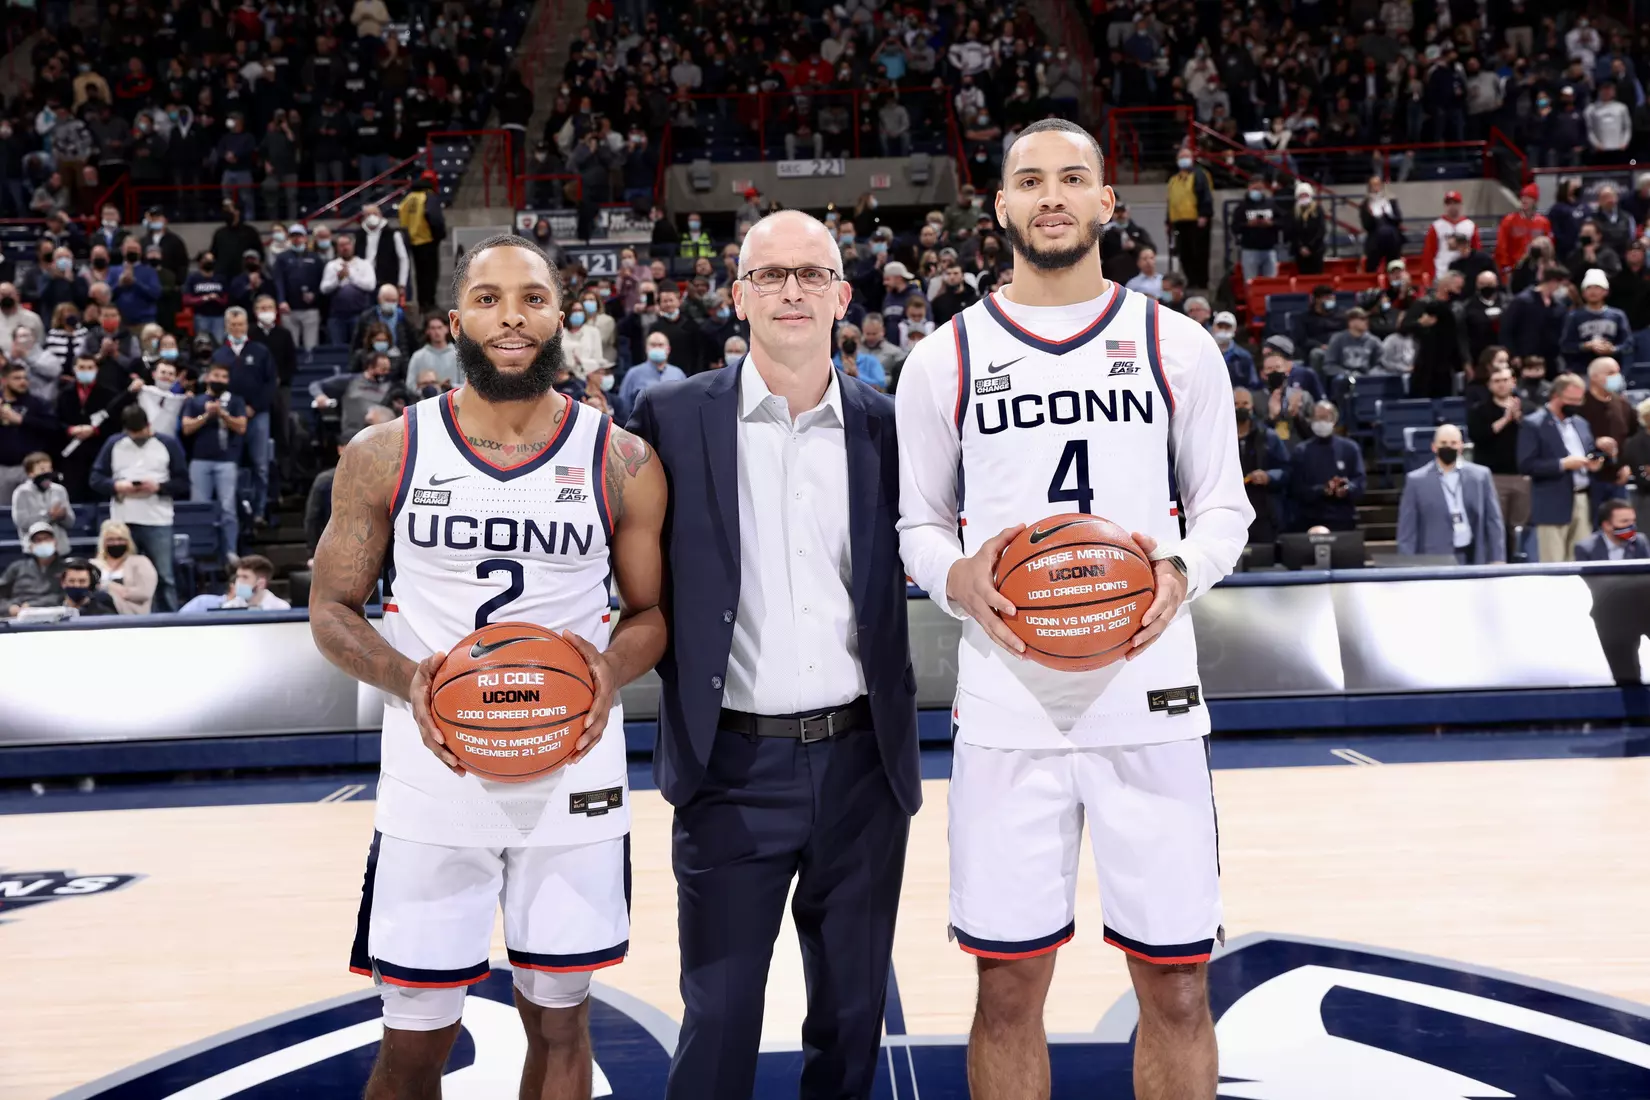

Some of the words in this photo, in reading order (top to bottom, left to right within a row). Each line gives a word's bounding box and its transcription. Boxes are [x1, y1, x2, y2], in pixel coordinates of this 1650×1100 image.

[811, 158, 844, 176] 221
[580, 253, 618, 276] 121
[976, 384, 1009, 394] CHANGE
[976, 389, 1152, 434] UCONN
[1047, 439, 1094, 514] 4
[413, 497, 449, 505] CHANGE
[557, 493, 588, 501] EAST
[408, 512, 593, 555] UCONN
[1025, 551, 1073, 572] TYRESE
[1077, 549, 1125, 561] MARTIN
[1049, 564, 1106, 582] UCONN
[475, 558, 524, 631] 2
[1053, 585, 1093, 597] CAREER
[1095, 580, 1128, 592] POINTS
[1026, 615, 1059, 626] UCONN
[1062, 617, 1078, 625] VS
[1081, 602, 1137, 624] MARQUETTE
[1036, 627, 1090, 637] DECEMBER
[1093, 624, 1107, 633] 21,
[1108, 616, 1130, 630] 2021
[477, 673, 499, 687] RJ
[503, 672, 545, 685] COLE
[482, 690, 540, 704] UCONN
[456, 709, 484, 720] 2,000
[487, 707, 529, 720] CAREER
[531, 705, 567, 717] POINTS
[455, 730, 489, 746] UCONN
[491, 739, 507, 747] VS
[509, 726, 570, 747] MARQUETTE
[464, 745, 519, 758] DECEMBER
[537, 741, 561, 754] 2021
